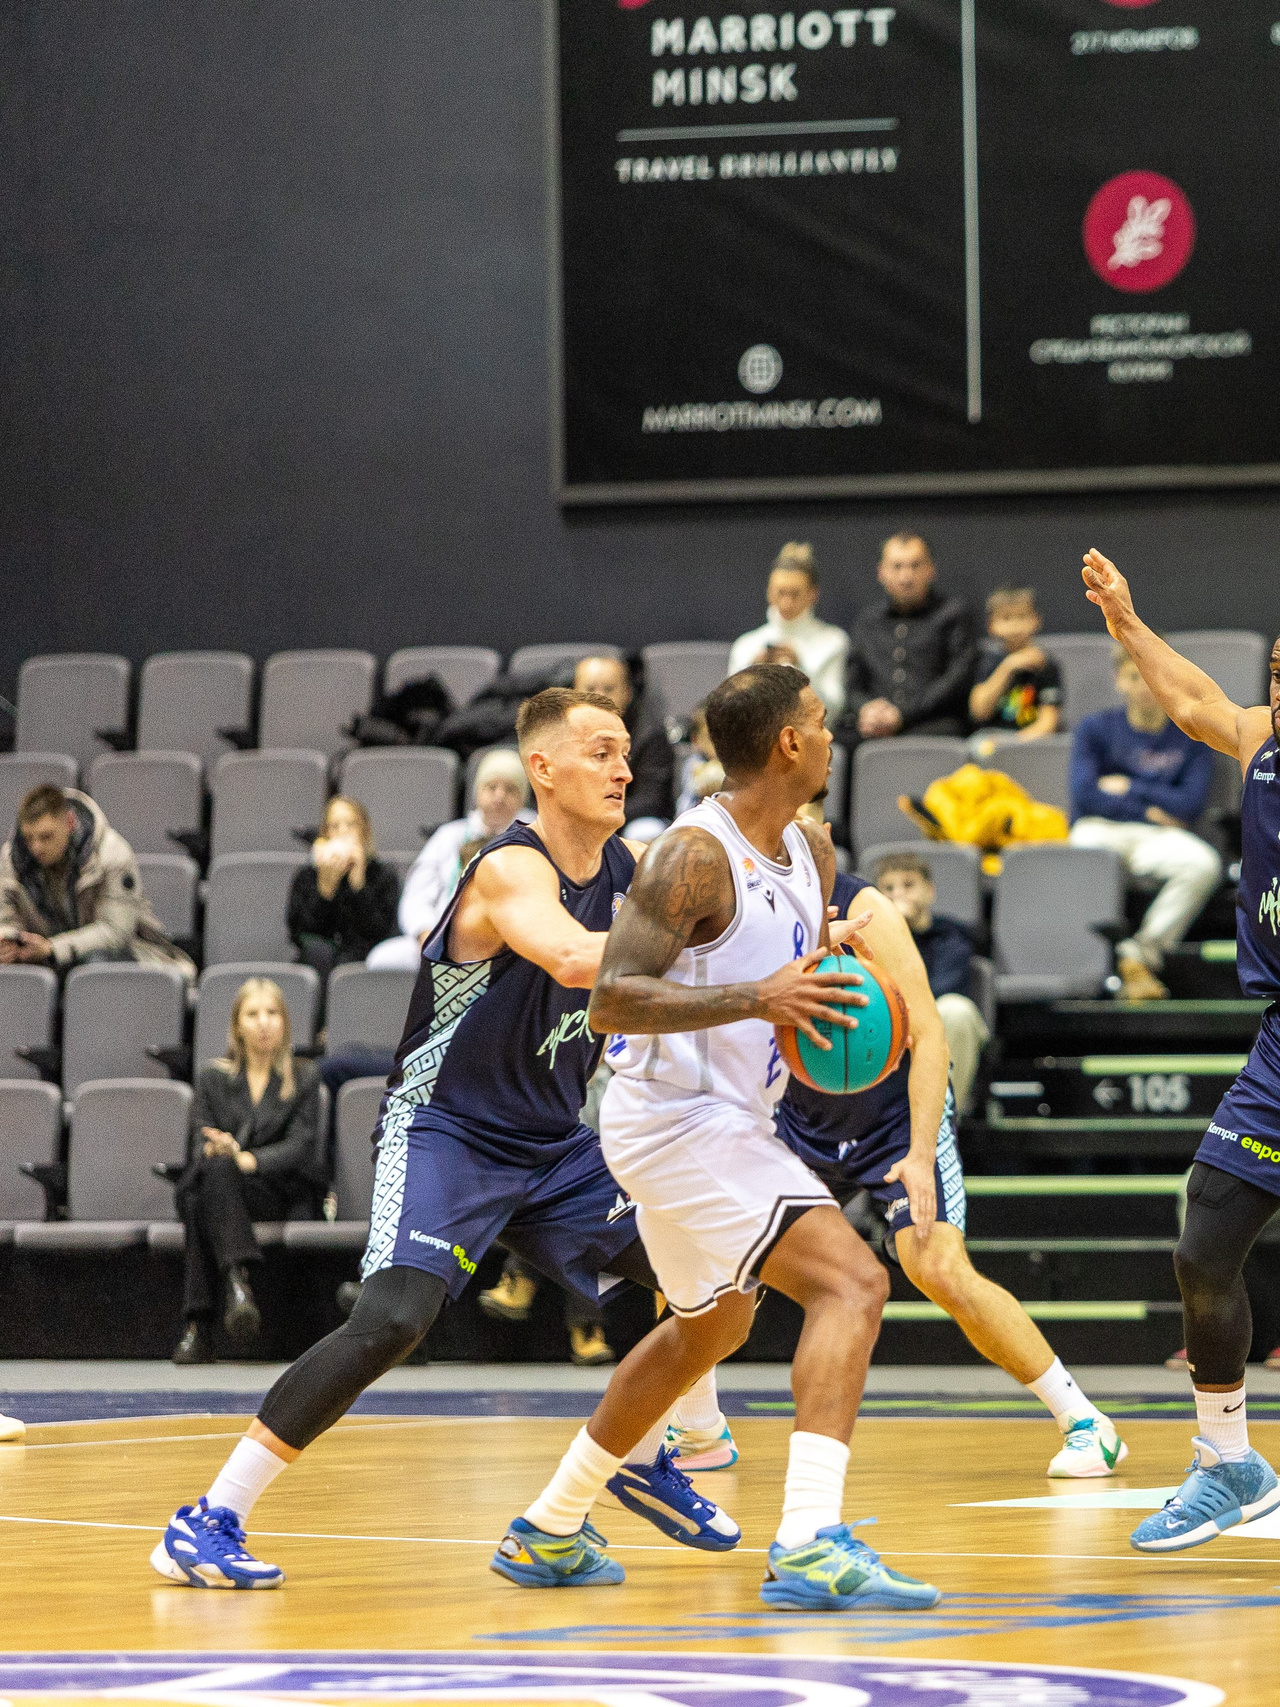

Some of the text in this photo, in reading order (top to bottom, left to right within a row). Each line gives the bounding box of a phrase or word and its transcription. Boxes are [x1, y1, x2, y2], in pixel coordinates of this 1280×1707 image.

[651, 8, 896, 57] MARRIOTT
[651, 63, 799, 107] MINSK
[615, 155, 714, 184] TRAVEL
[1206, 1122, 1239, 1142] Kempa
[409, 1229, 452, 1251] Kempa
